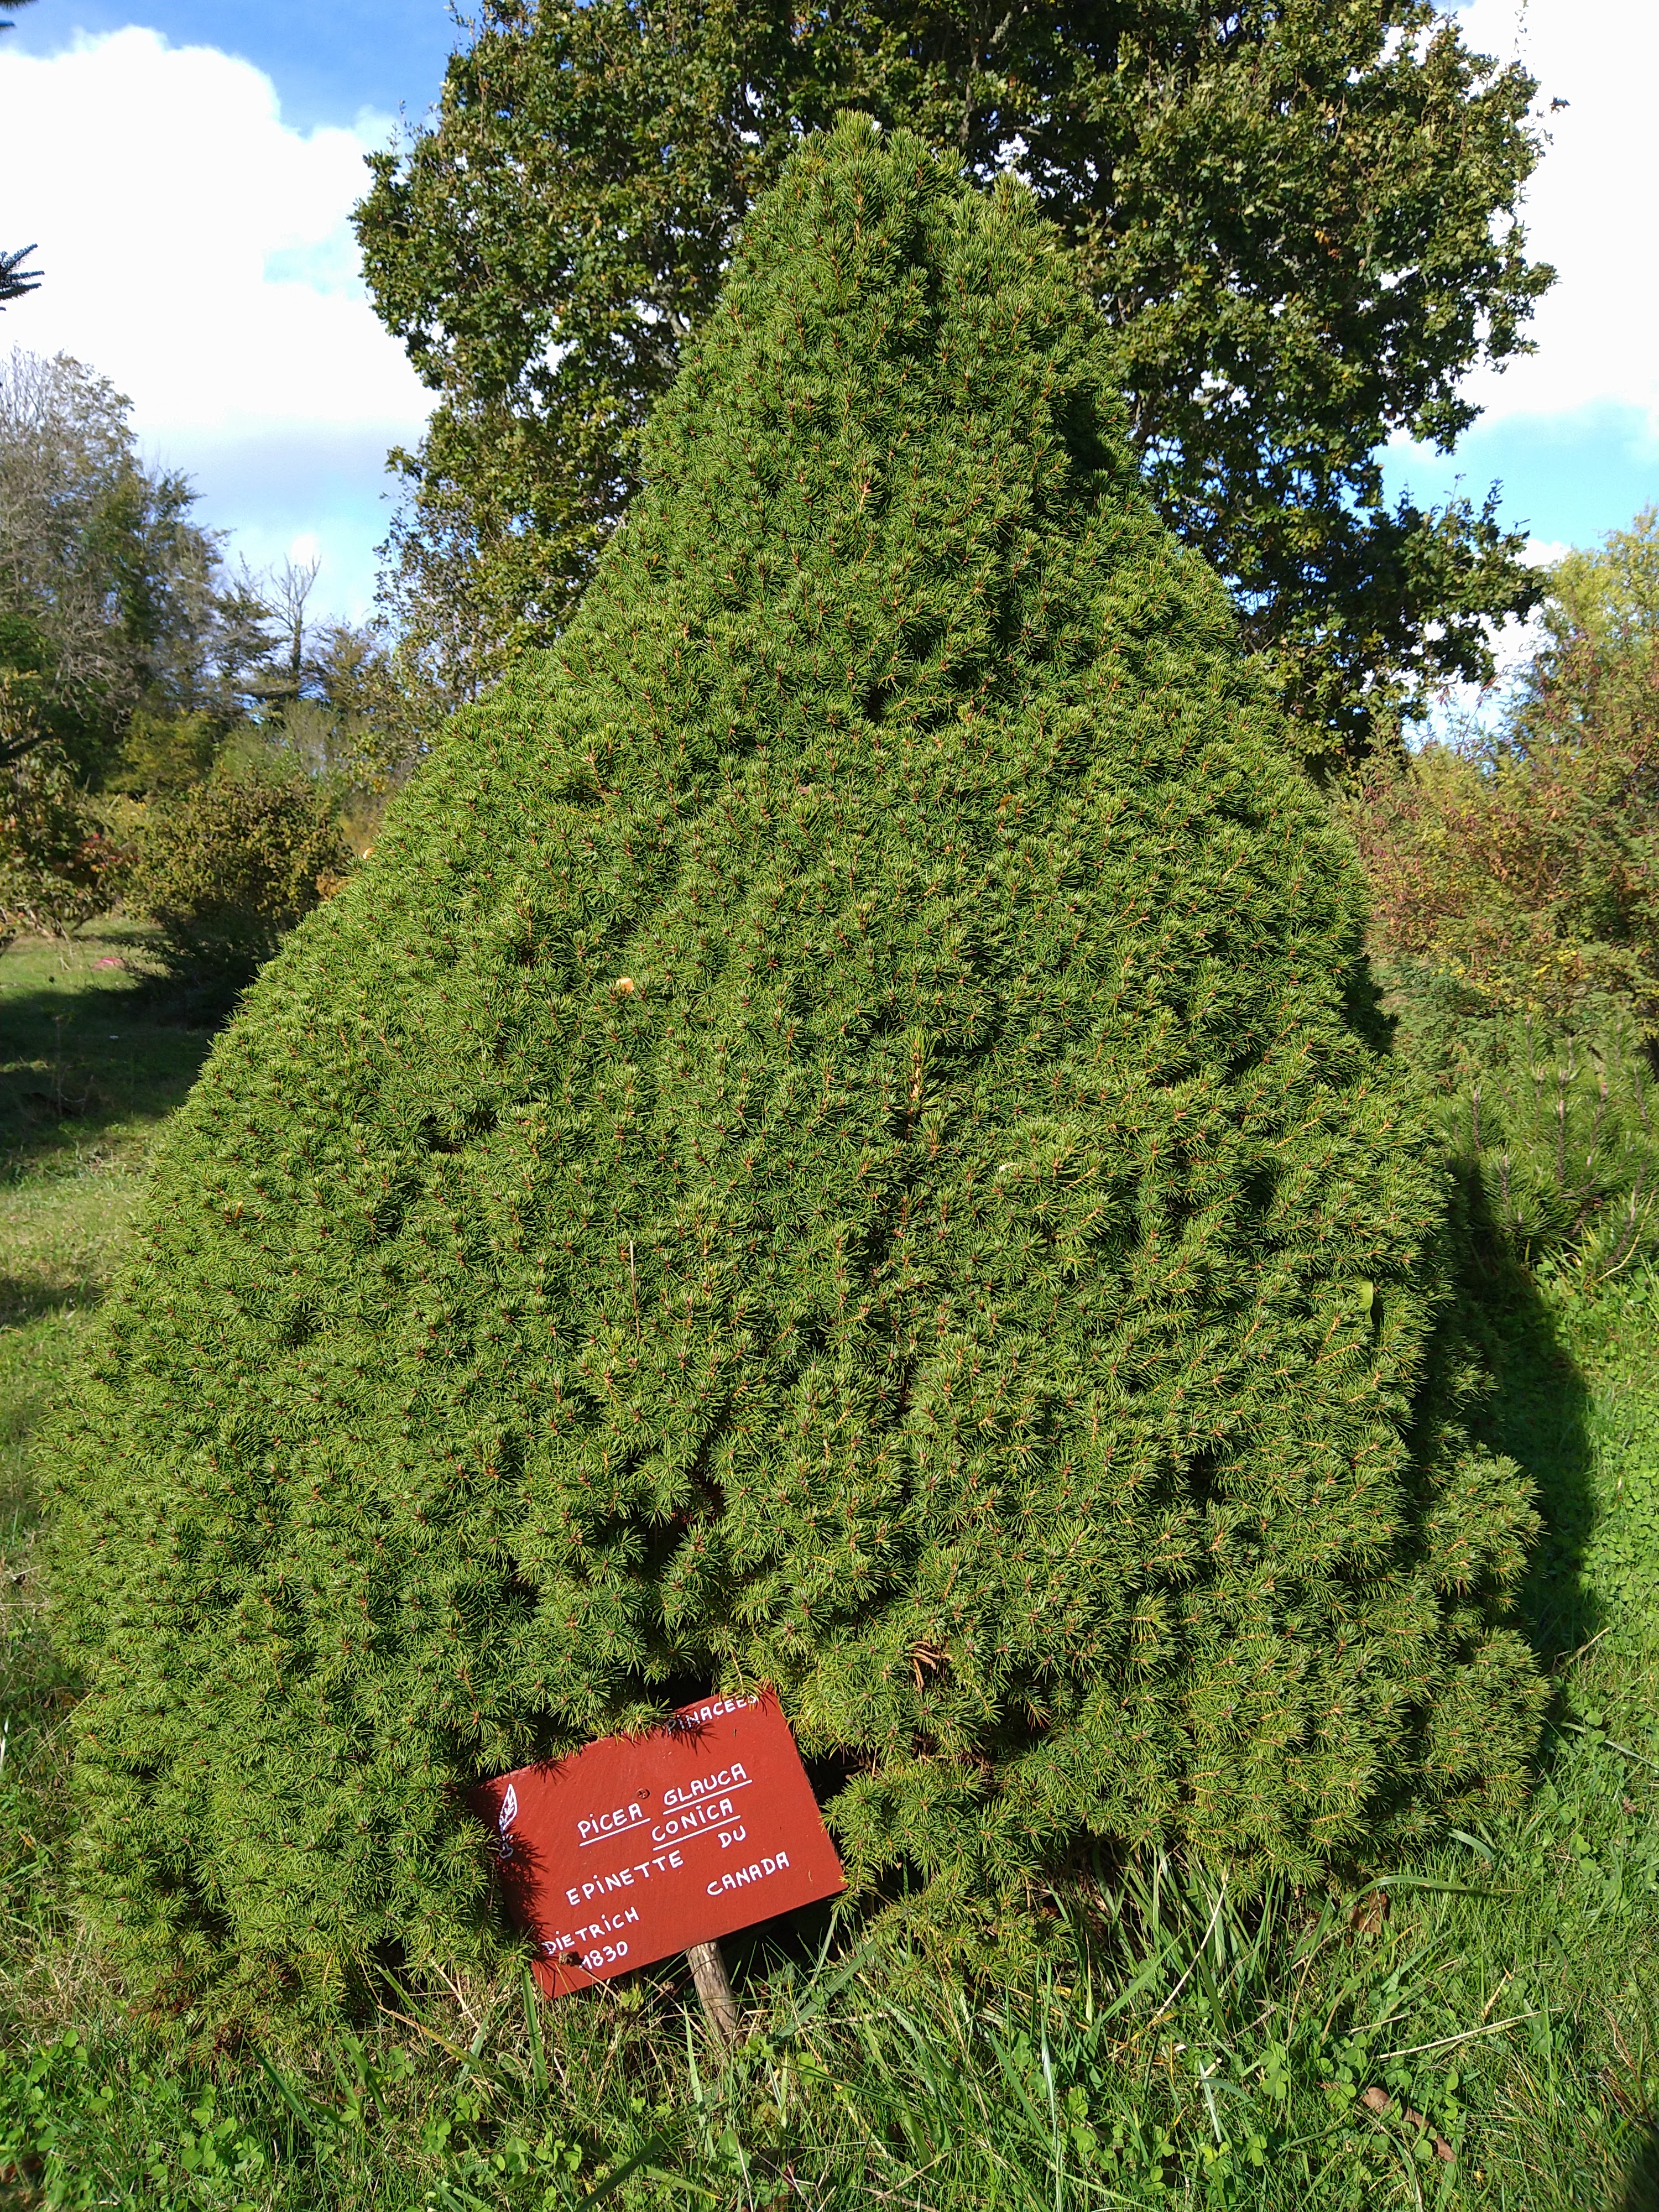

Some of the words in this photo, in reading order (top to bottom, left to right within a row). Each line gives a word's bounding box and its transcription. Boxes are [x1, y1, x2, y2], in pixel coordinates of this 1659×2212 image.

[663, 1762, 747, 1806] GLAUCA
[717, 1825, 747, 1848] DU
[706, 1851, 790, 1896] CANADA
[578, 1941, 628, 1970] 1830
